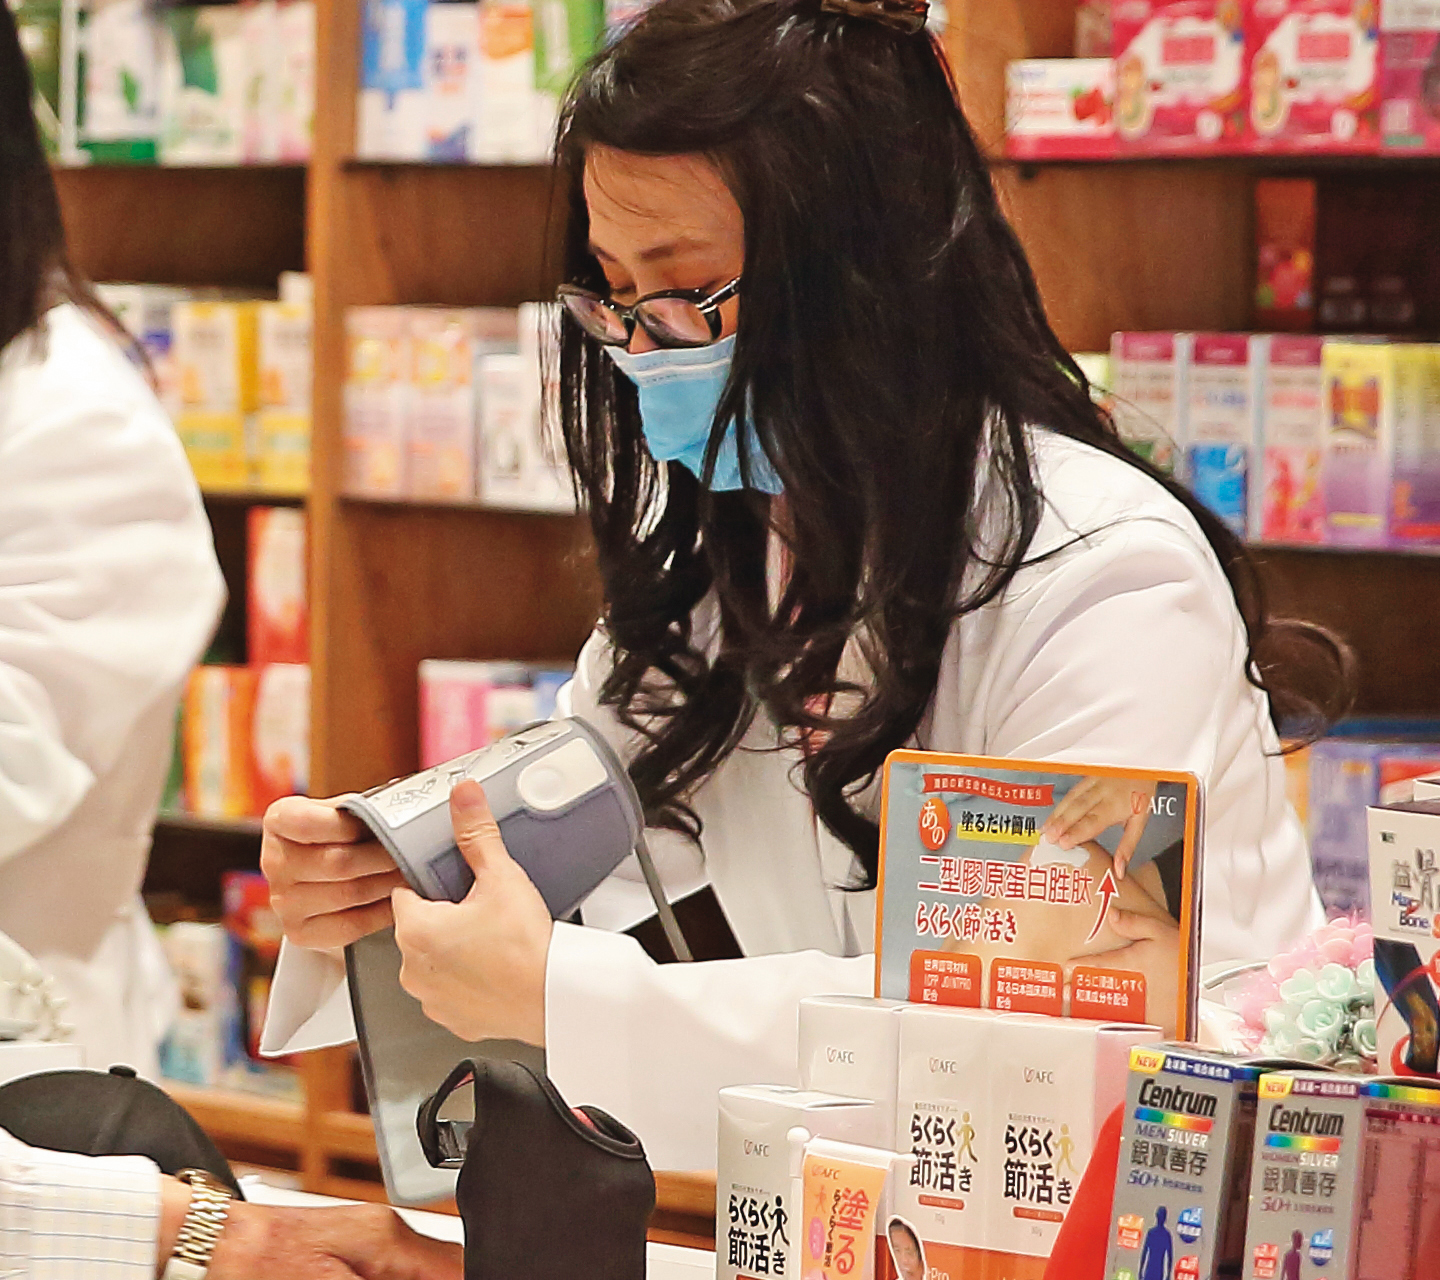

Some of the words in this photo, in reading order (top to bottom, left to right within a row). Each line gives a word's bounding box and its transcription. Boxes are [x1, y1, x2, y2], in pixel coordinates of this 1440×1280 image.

[1144, 795, 1178, 817] AFC
[921, 801, 946, 846] あの
[961, 811, 1037, 837] 塗るだけ簡単
[918, 855, 1093, 905] 二型膠原蛋白胜肽
[916, 902, 1018, 943] らくらく節活き
[922, 990, 939, 1002] 配合
[996, 996, 1012, 1008] 配合
[837, 1051, 855, 1065] AFC
[938, 1060, 957, 1074] AFC
[1135, 1054, 1160, 1069] NEW
[1035, 1070, 1055, 1085] AFC
[1138, 1077, 1218, 1117] Centrum
[909, 1113, 957, 1147] らくらく
[1135, 1122, 1166, 1139] MEN
[1167, 1128, 1209, 1148] SILVER
[1268, 1104, 1345, 1136] Centrum
[752, 1144, 770, 1158] AFC
[1004, 1124, 1054, 1159] らくらく
[1130, 1139, 1209, 1176] 銀寶善存
[822, 1168, 841, 1180] AFC
[909, 1145, 973, 1193] 節活き
[1298, 1153, 1339, 1169] SILVER
[1003, 1157, 1073, 1205] 節活き
[1263, 1166, 1337, 1198] 銀寶善存
[728, 1193, 770, 1229] らくらく
[834, 1187, 870, 1275] 塗る
[727, 1225, 787, 1276] 節活き
